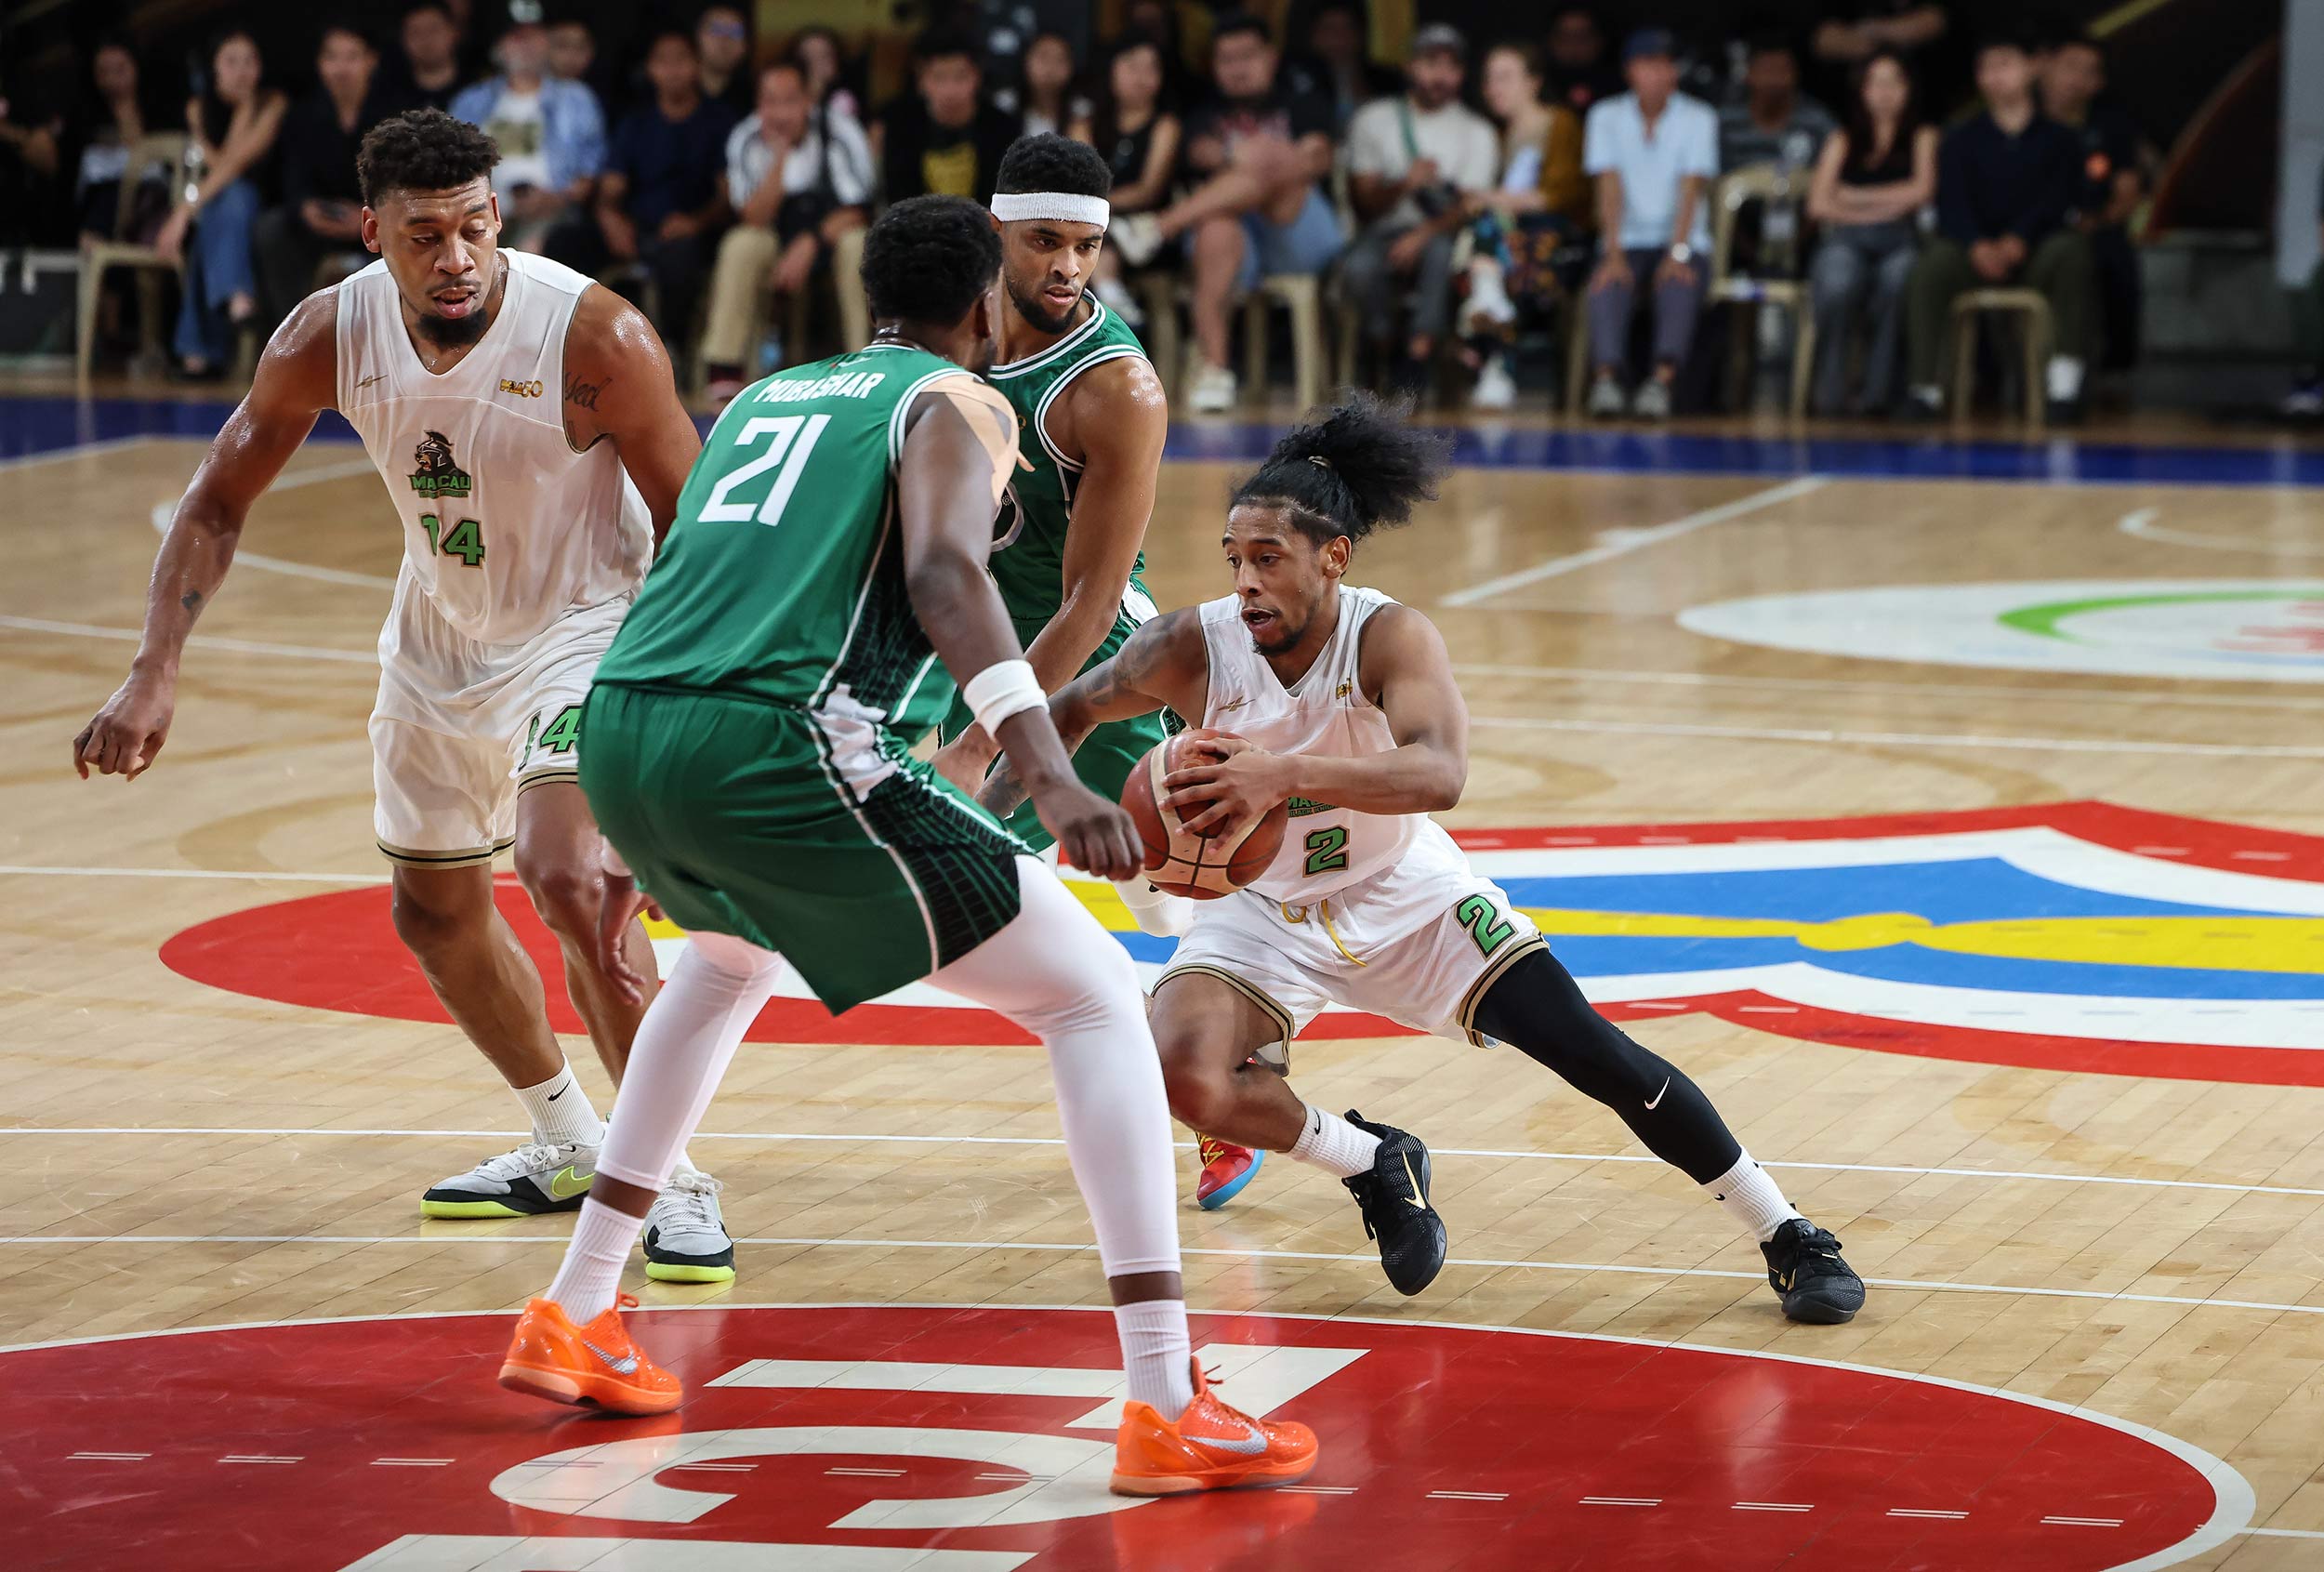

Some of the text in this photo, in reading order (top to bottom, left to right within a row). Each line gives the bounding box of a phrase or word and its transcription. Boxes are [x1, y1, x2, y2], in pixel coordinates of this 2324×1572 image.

[752, 372, 886, 403] MUBASHAR
[410, 474, 471, 491] MACAU
[696, 414, 832, 526] 21
[417, 512, 485, 568] 14
[1302, 824, 1351, 878] 2
[1451, 893, 1520, 961] 2
